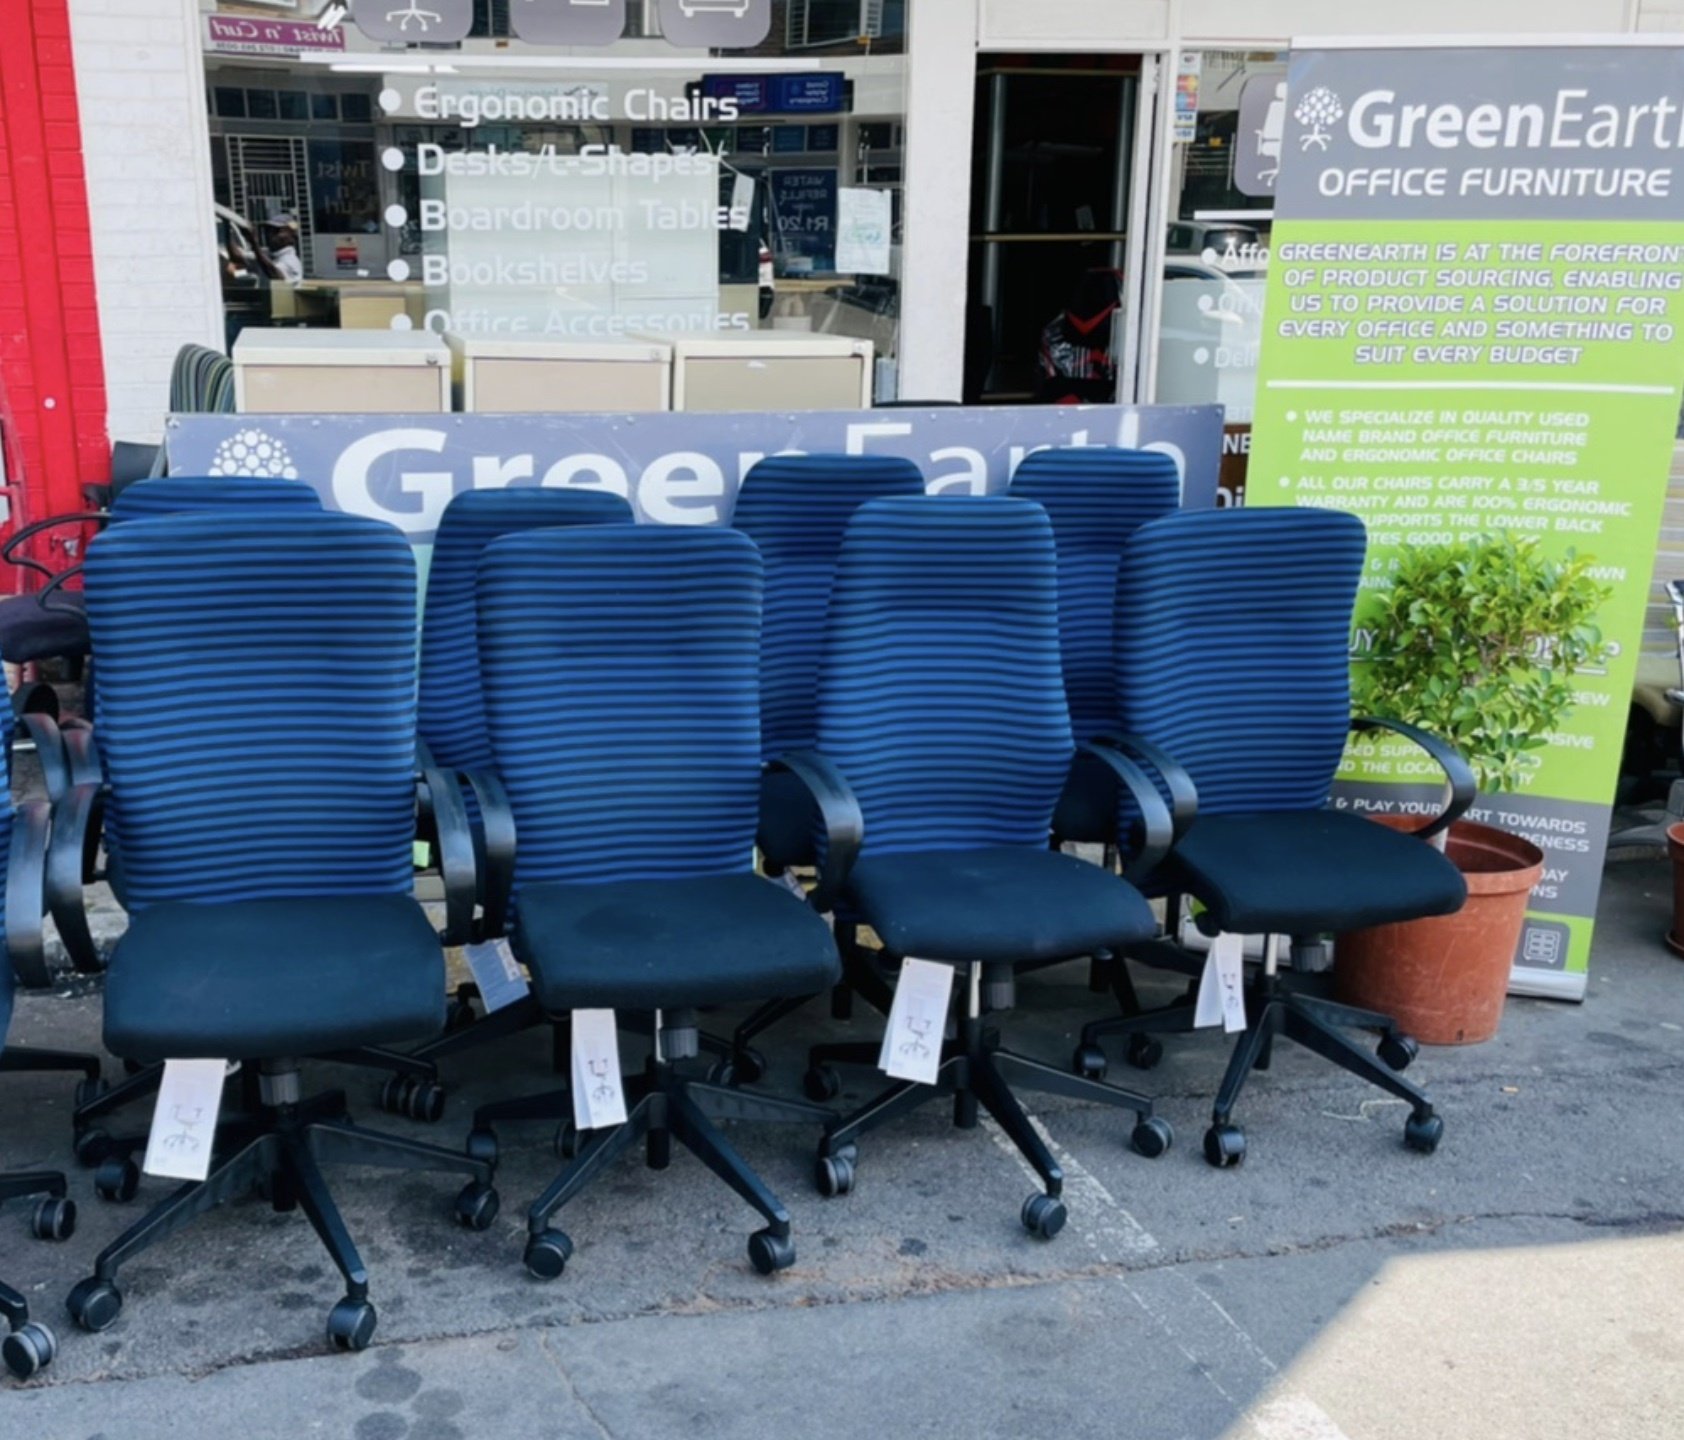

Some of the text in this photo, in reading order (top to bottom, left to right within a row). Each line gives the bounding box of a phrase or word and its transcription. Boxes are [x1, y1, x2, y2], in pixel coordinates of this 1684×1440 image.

[414, 87, 610, 126] Ergonomic
[624, 88, 738, 121] Chairs
[1318, 168, 1671, 196] OFFICE FURNITURE
[420, 199, 750, 231] Boardroom Tables
[1278, 243, 1428, 261] GREENEARTH
[1435, 243, 1458, 261] IS
[1463, 243, 1491, 261] AT
[1498, 243, 1542, 261] THE
[423, 254, 648, 286] Bookshelves
[1284, 269, 1316, 287] OF
[1322, 269, 1430, 287] PRODUCT
[1563, 270, 1682, 289] ENABLING
[1291, 295, 1667, 315] US TO PROVIDE A SOLUTION FOR
[424, 307, 750, 334] Office Accessories
[1278, 320, 1673, 341] EVERY OFFICE AND SOMETHING TO
[1355, 345, 1583, 364] SUIT EVERY BUDGET
[1304, 410, 1590, 427] WE SPECIALIZE IN QUALITY USED
[1302, 429, 1588, 446] NAME BRAND OFFICE FURNITURE
[1300, 448, 1578, 466] AND ERGONOMIC OFFICE CHAIRS
[1297, 476, 1600, 495] ALL OUR CHAIRS CARRY A 3/5 YEAR
[1296, 495, 1388, 508] WARRANTY
[1394, 495, 1428, 508] AND
[1434, 495, 1467, 508] ARE
[1523, 497, 1633, 517] ERGONOMIC
[1362, 514, 1604, 533] UPPORTS THE LOWER BACK
[1407, 531, 1454, 545] GOOD
[1362, 762, 1393, 774] THE
[1353, 798, 1395, 812] PLAY
[1398, 801, 1443, 816] YOUR
[1461, 807, 1493, 823] ART
[1497, 811, 1588, 834] TOWARDS
